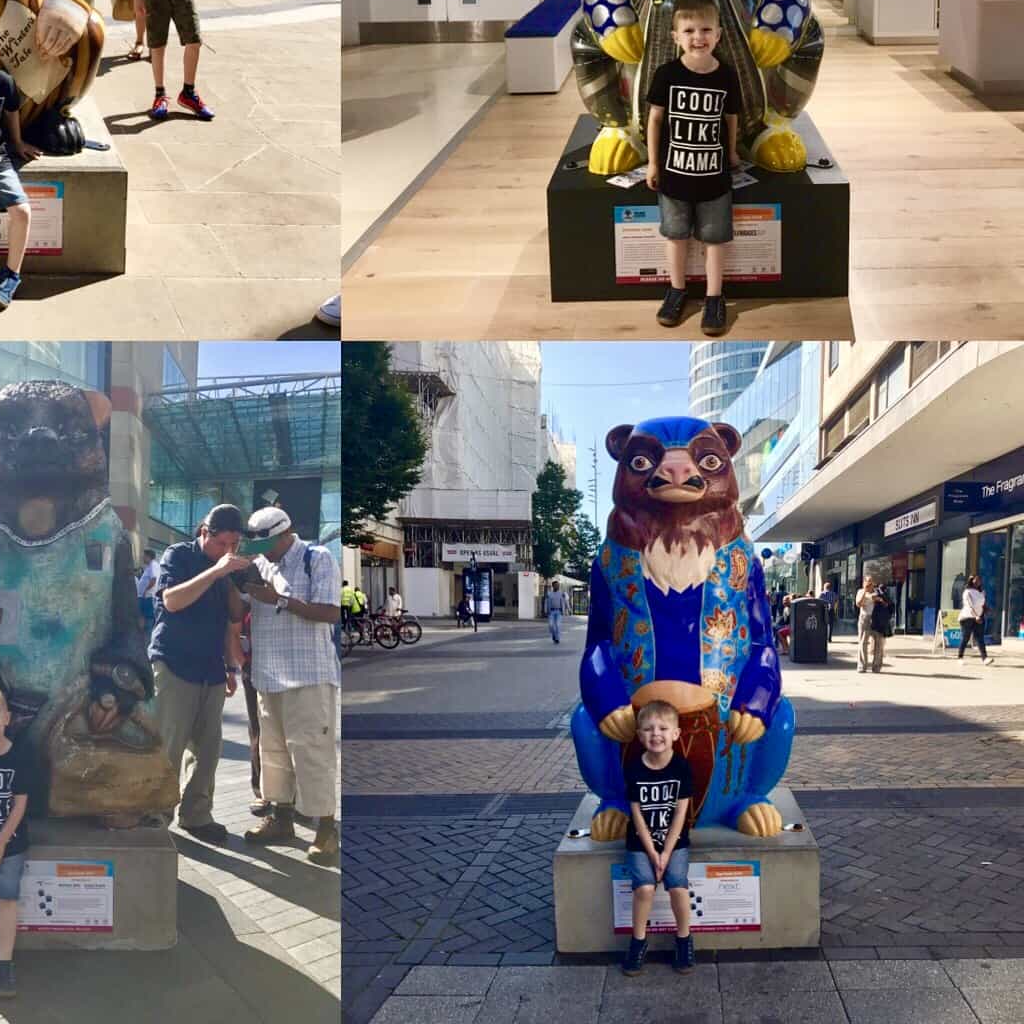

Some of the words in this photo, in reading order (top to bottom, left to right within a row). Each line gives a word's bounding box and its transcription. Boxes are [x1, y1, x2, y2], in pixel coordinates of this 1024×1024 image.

[677, 90, 720, 112] COOL
[674, 119, 718, 142] LIKE
[673, 150, 718, 171] MAMA
[982, 486, 995, 498] The
[997, 474, 1024, 493] Fragra
[639, 784, 674, 803] COOL
